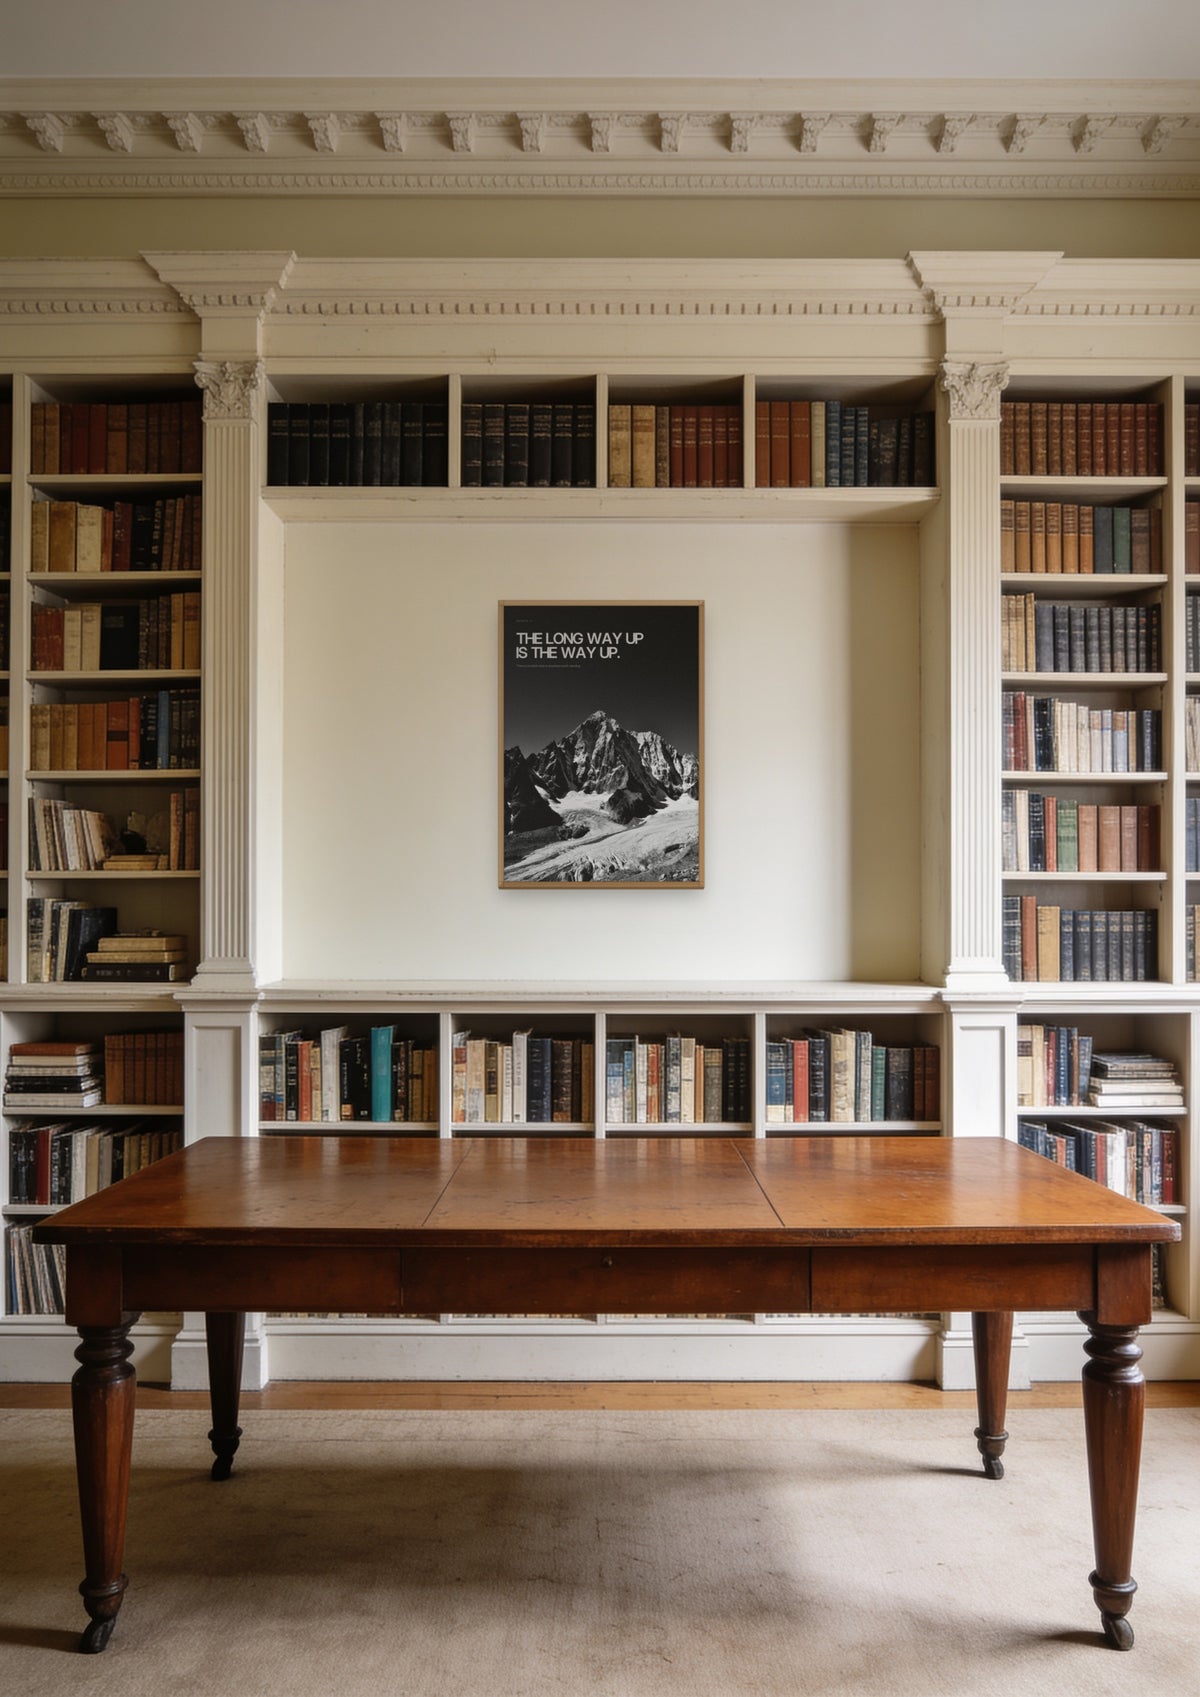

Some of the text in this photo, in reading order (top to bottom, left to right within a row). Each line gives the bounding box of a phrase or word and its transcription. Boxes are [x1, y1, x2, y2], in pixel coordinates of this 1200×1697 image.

[516, 632, 644, 645] THE LONG WAY UP
[516, 646, 621, 659] IS THE WAY UP.
